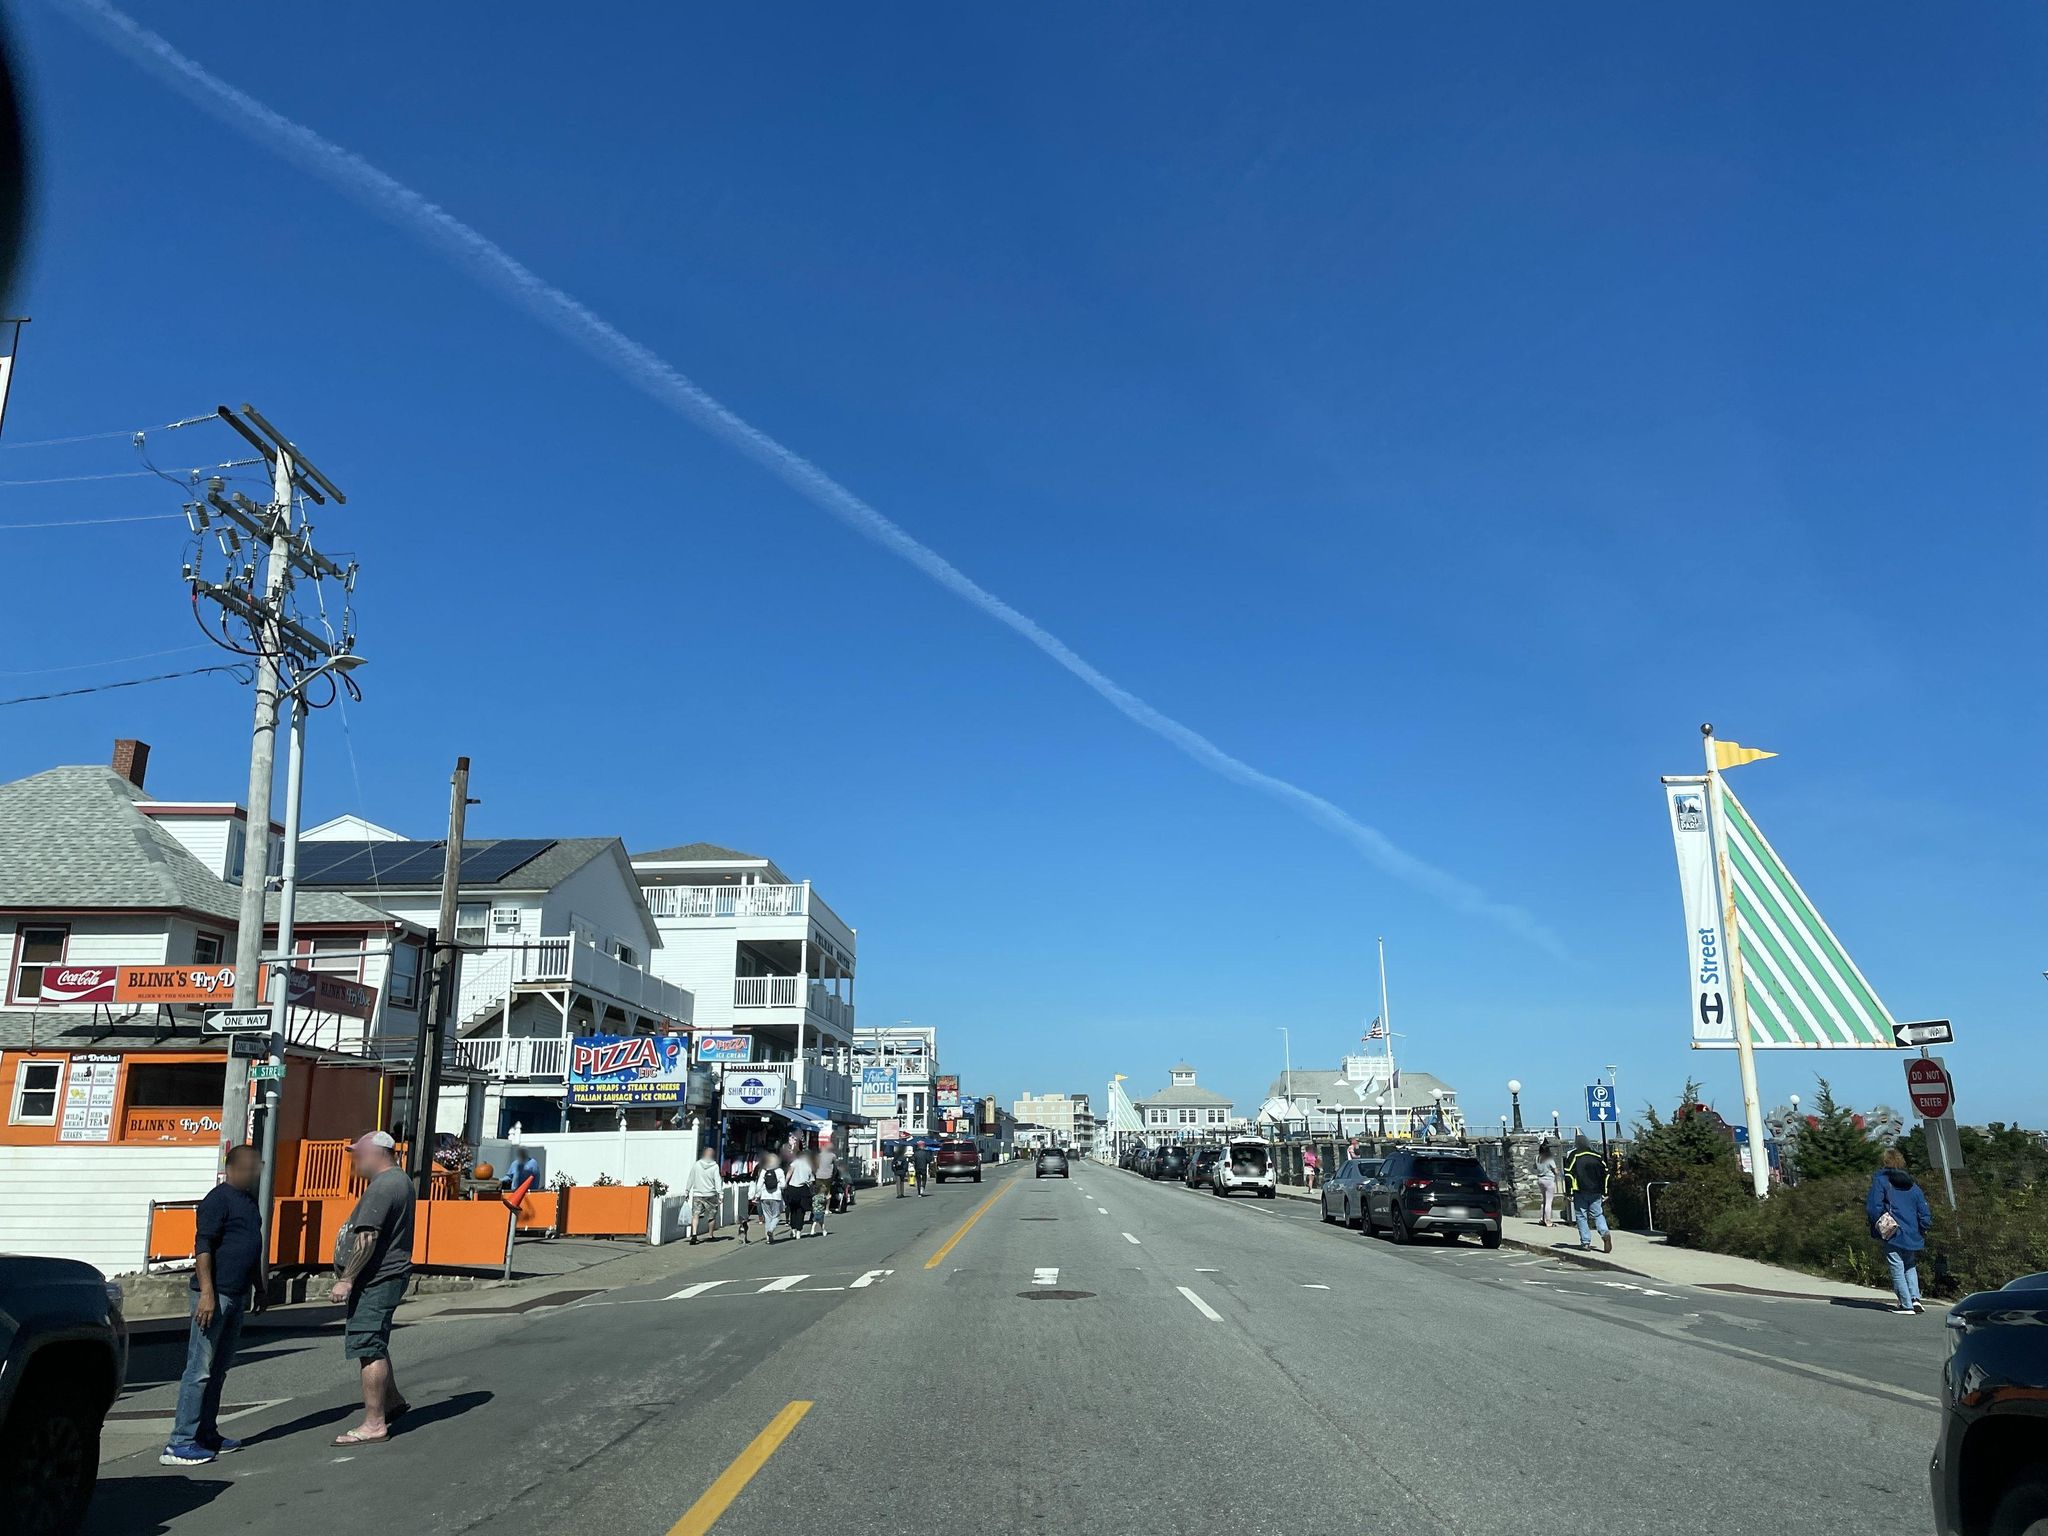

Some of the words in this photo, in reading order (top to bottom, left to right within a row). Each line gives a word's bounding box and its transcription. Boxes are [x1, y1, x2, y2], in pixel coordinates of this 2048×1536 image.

[1698, 927, 1719, 985] Street
[128, 970, 188, 988] BLINK'S
[190, 970, 219, 993] Fry
[1700, 992, 1724, 1025] H
[224, 1016, 243, 1026] ONE
[246, 1016, 265, 1025] WAY
[716, 1037, 747, 1051] PIZZA
[88, 1054, 120, 1062] Drinks!
[573, 1037, 660, 1075] PIZZA
[638, 1067, 657, 1078] ETC
[1912, 1071, 1922, 1081] DO
[1926, 1070, 1940, 1080] NOT
[572, 1083, 589, 1092] SUBS
[596, 1083, 619, 1092] WRAPS
[627, 1083, 648, 1092] STEAK
[656, 1083, 680, 1091] CHEESE
[728, 1087, 746, 1096] SHIRT
[748, 1087, 776, 1096] FACTORY
[863, 1082, 895, 1094] MOTEL
[574, 1093, 602, 1102] ITALIAN
[603, 1093, 633, 1101] SAUSAGE
[641, 1093, 651, 1101] ICE
[653, 1093, 677, 1101] CREAM
[1597, 1089, 1606, 1099] P
[1920, 1097, 1942, 1107] ENTER
[65, 1113, 80, 1121] WILD
[89, 1118, 103, 1127] TEA
[130, 1119, 176, 1131] BLINK'S
[180, 1117, 200, 1135] Fry
